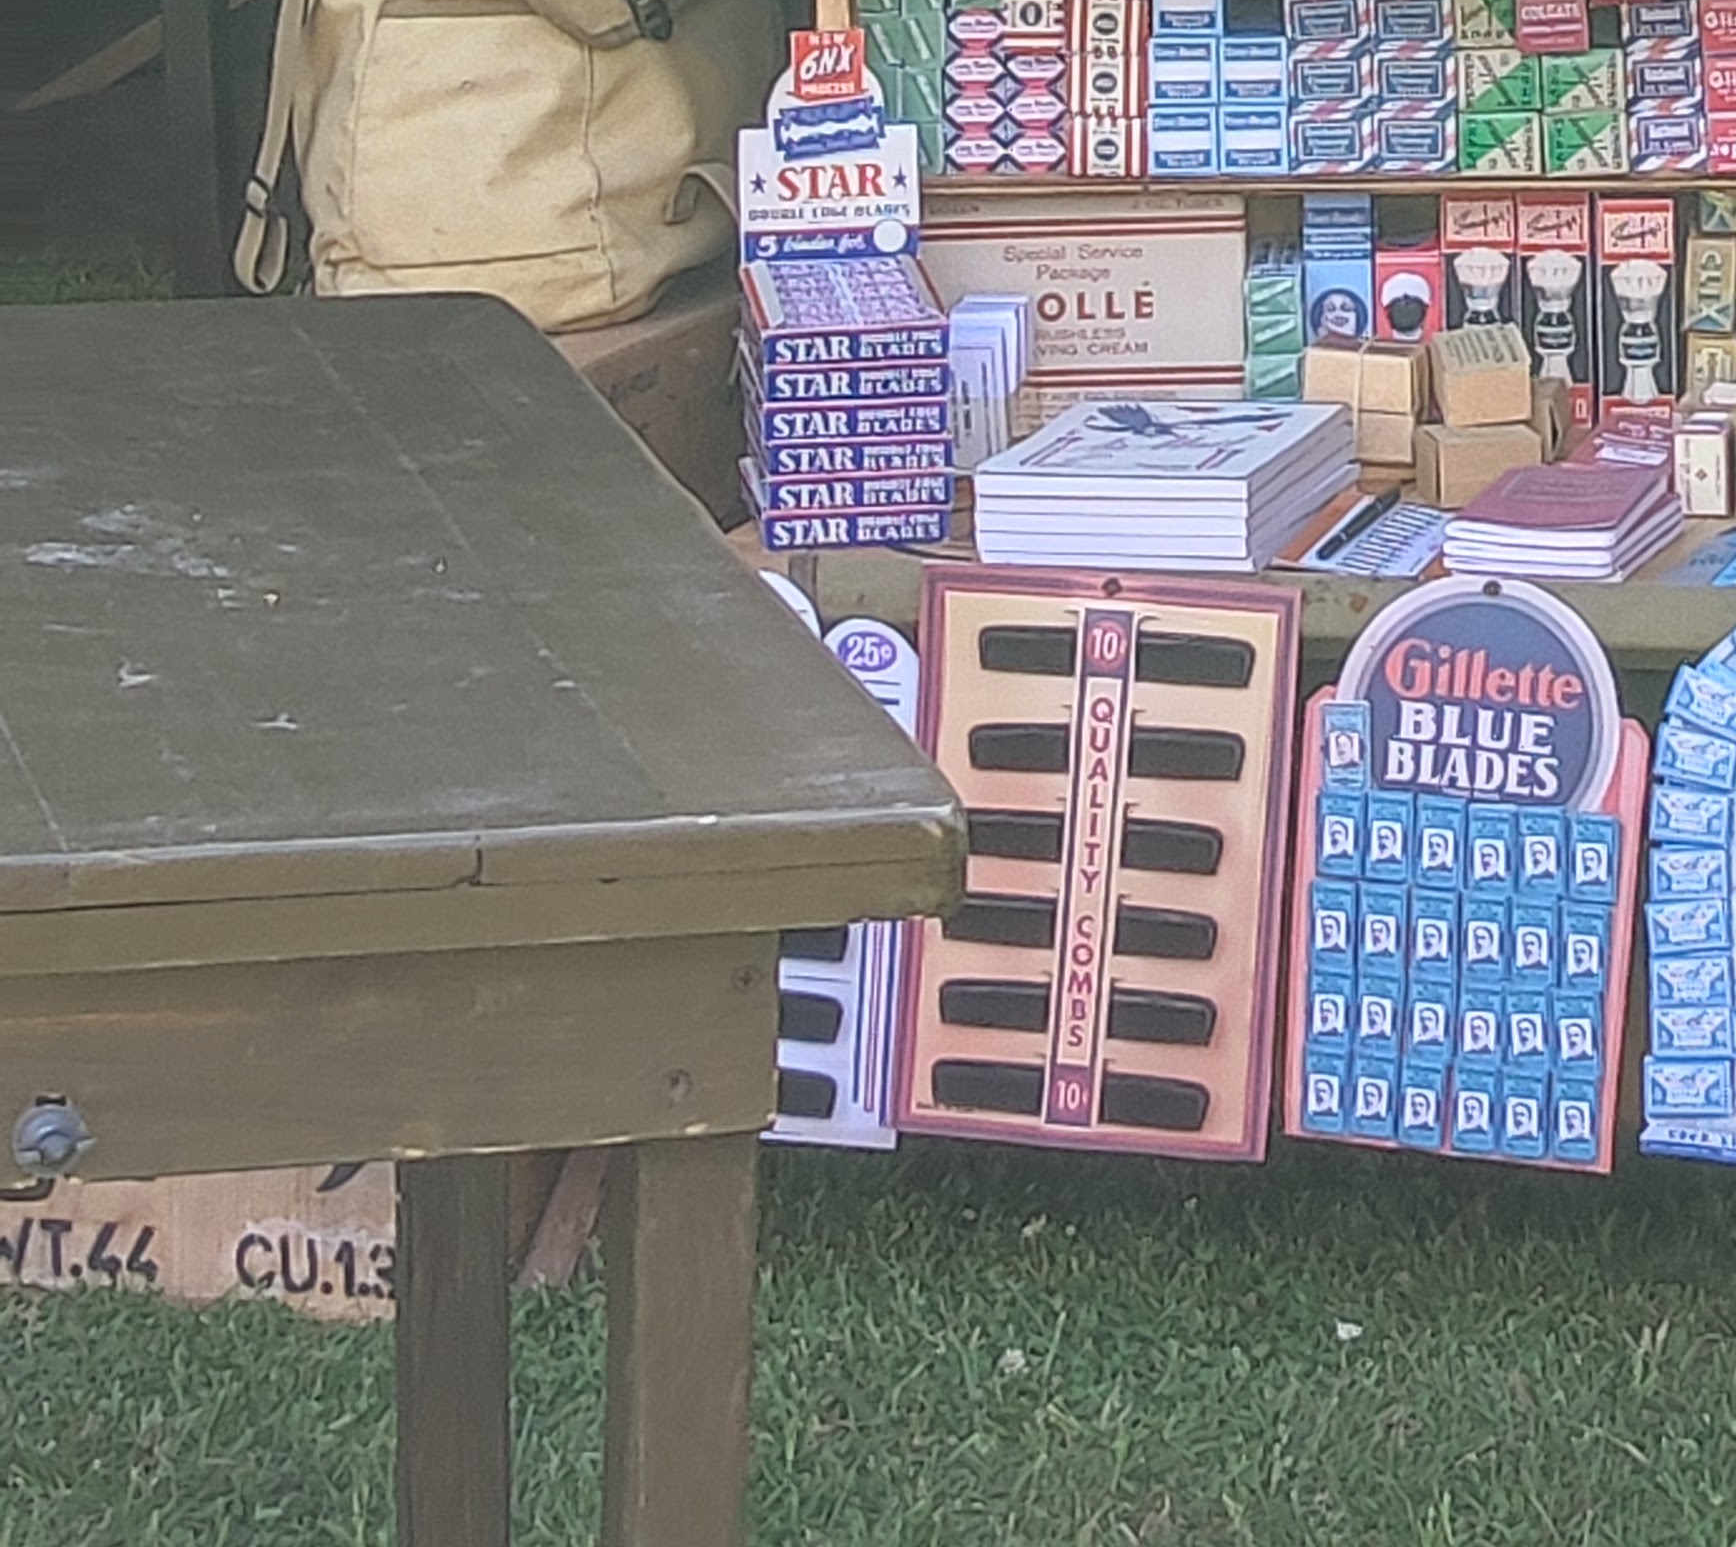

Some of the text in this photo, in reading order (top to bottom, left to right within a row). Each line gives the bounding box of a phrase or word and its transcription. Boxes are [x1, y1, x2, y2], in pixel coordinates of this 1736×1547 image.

[777, 162, 886, 203] STAR
[755, 235, 778, 256] 5
[1002, 244, 1144, 263] Special Service
[1035, 264, 1112, 282] Package
[1036, 280, 1155, 323] OLLÉ
[775, 336, 853, 363] STAR
[775, 371, 853, 398] STAR
[773, 410, 849, 438] STAR
[778, 445, 856, 473] STAR
[778, 481, 855, 509] STAR
[773, 517, 850, 547] STAR
[1384, 638, 1585, 709] Gillette
[1397, 700, 1555, 755] BLUE
[1384, 739, 1561, 798] BLADES
[1065, 696, 1116, 1050] QUALITY COMBS
